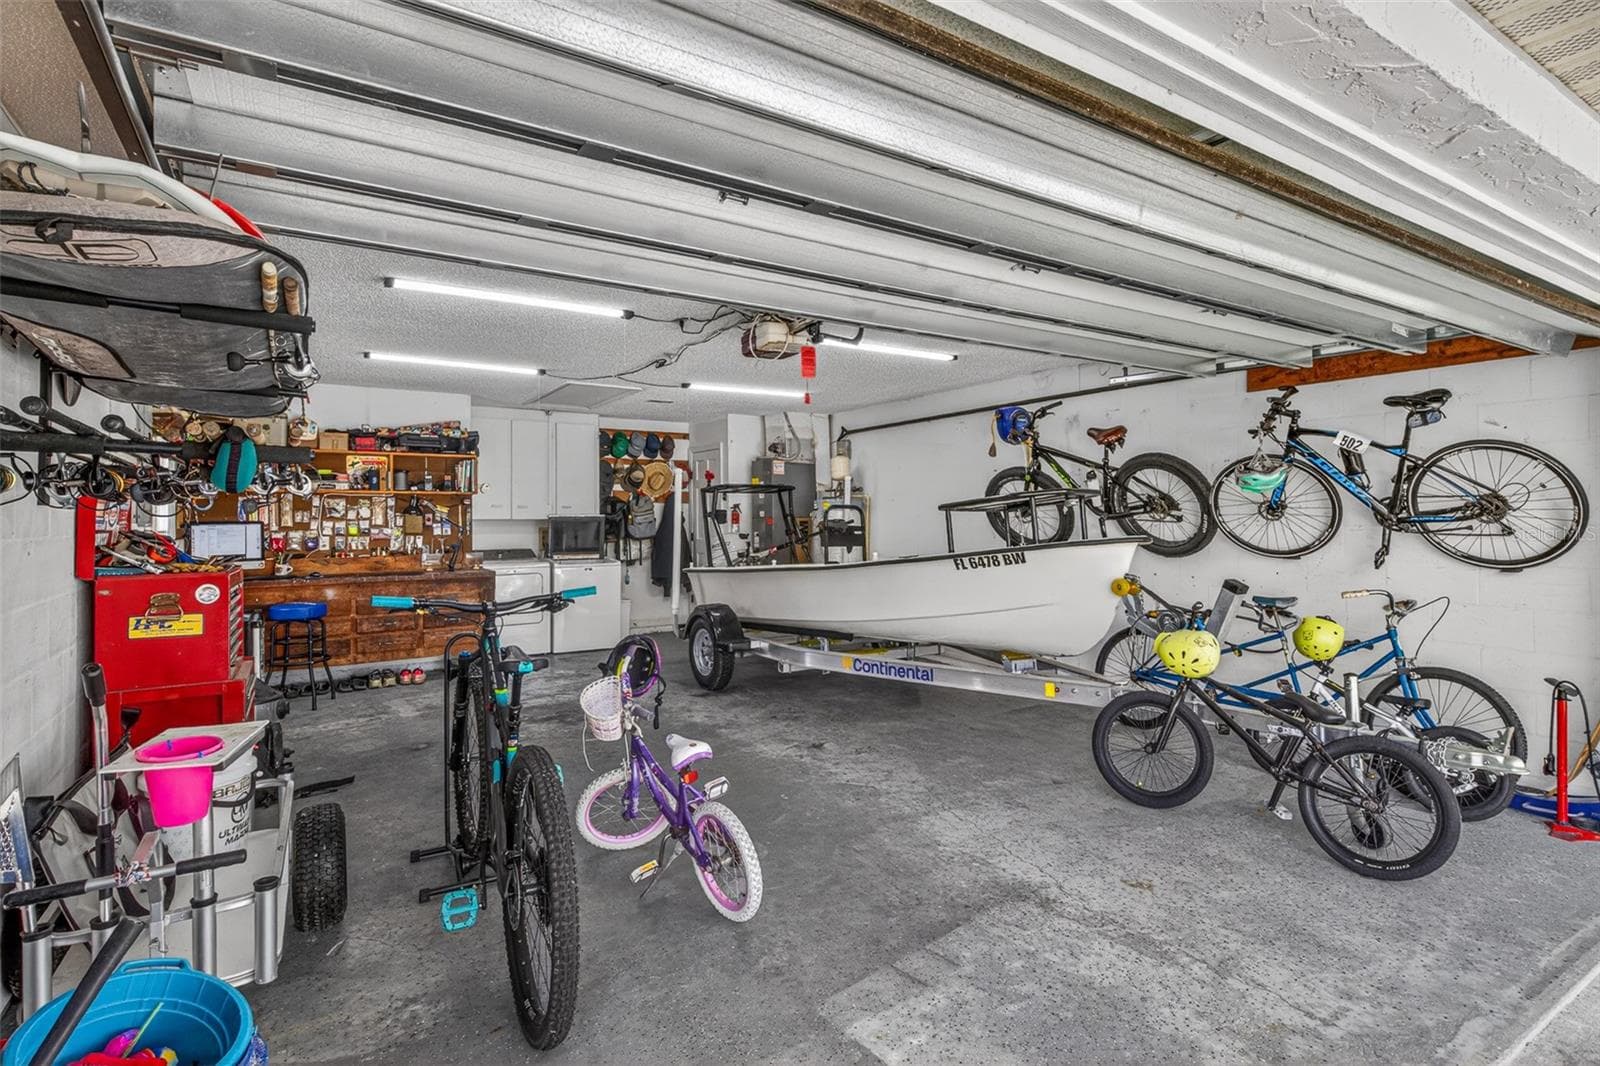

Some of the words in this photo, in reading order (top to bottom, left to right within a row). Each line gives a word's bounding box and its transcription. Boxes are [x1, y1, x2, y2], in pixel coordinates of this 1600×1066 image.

[1339, 435, 1363, 452] 502
[953, 558, 968, 570] FL
[968, 555, 1000, 569] 6478
[1002, 551, 1027, 566] BW
[853, 658, 934, 682] Continental
